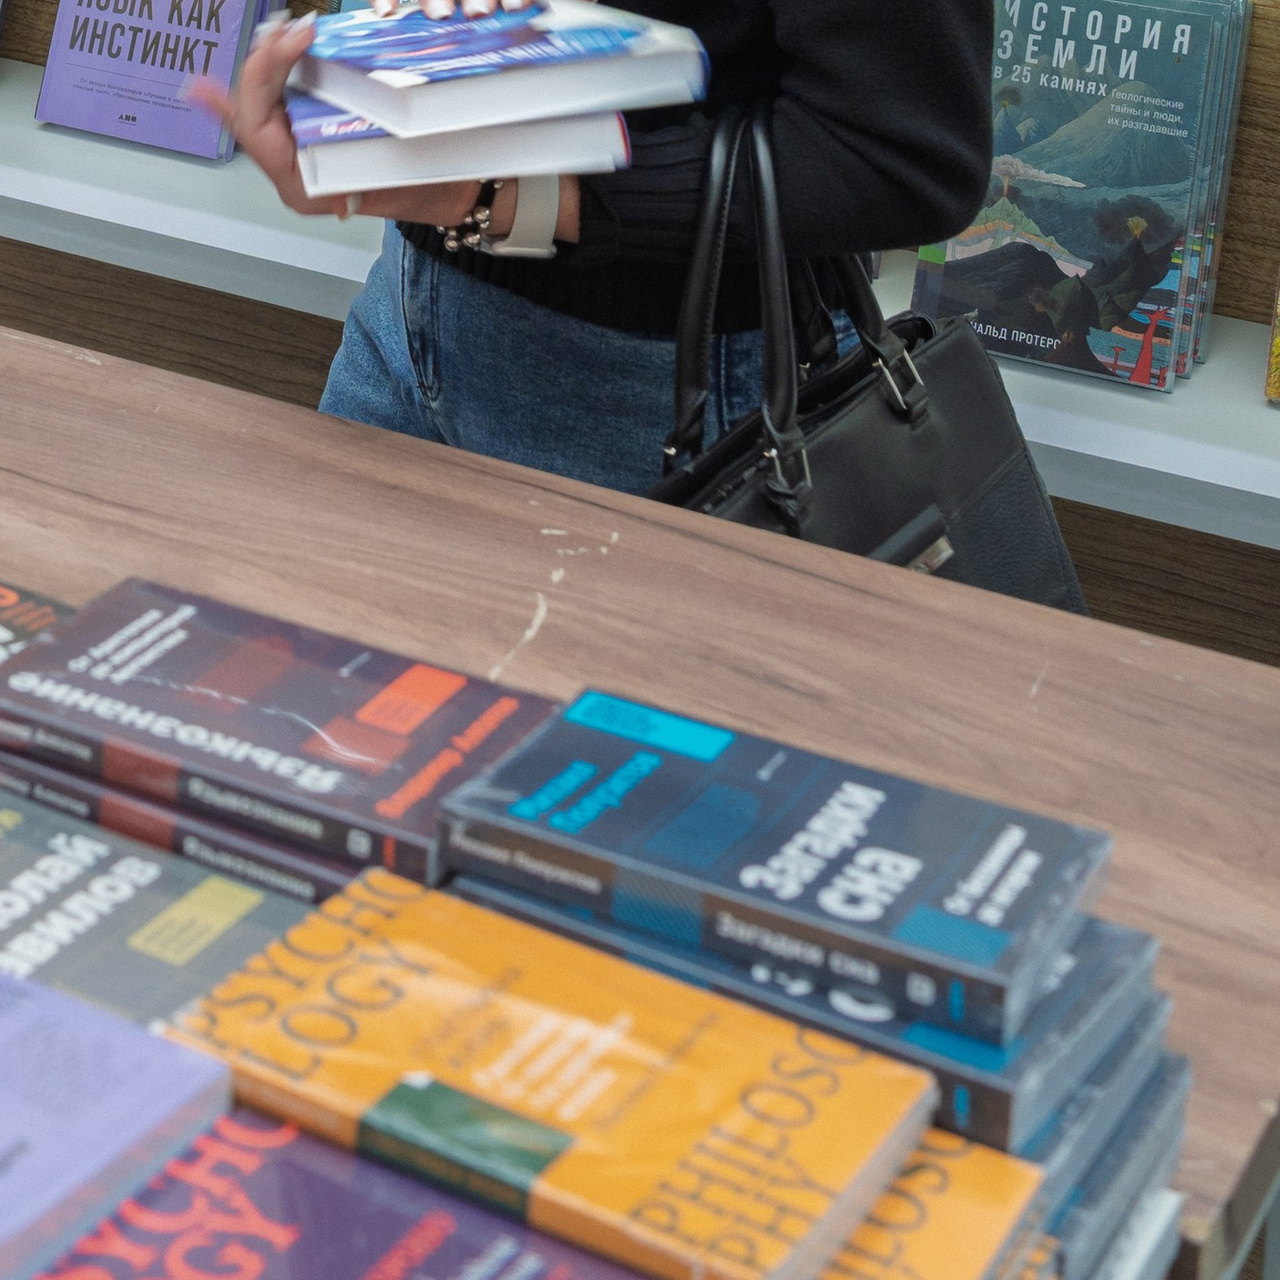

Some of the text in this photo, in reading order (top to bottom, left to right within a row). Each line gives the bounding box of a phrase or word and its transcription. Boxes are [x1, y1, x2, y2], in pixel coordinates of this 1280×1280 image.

[68, 16, 219, 77] ИНСТИНКТ
[996, 29, 1138, 81] ЗЕМЛИ
[993, 63, 1109, 98] в 25 камнях
[1111, 87, 1185, 111] Геологические
[1107, 115, 1188, 139] их разгадавшие
[1109, 102, 1142, 120] тайны
[7, 669, 348, 794] Языкознание
[727, 774, 898, 905] Загадки
[803, 841, 930, 928] сна
